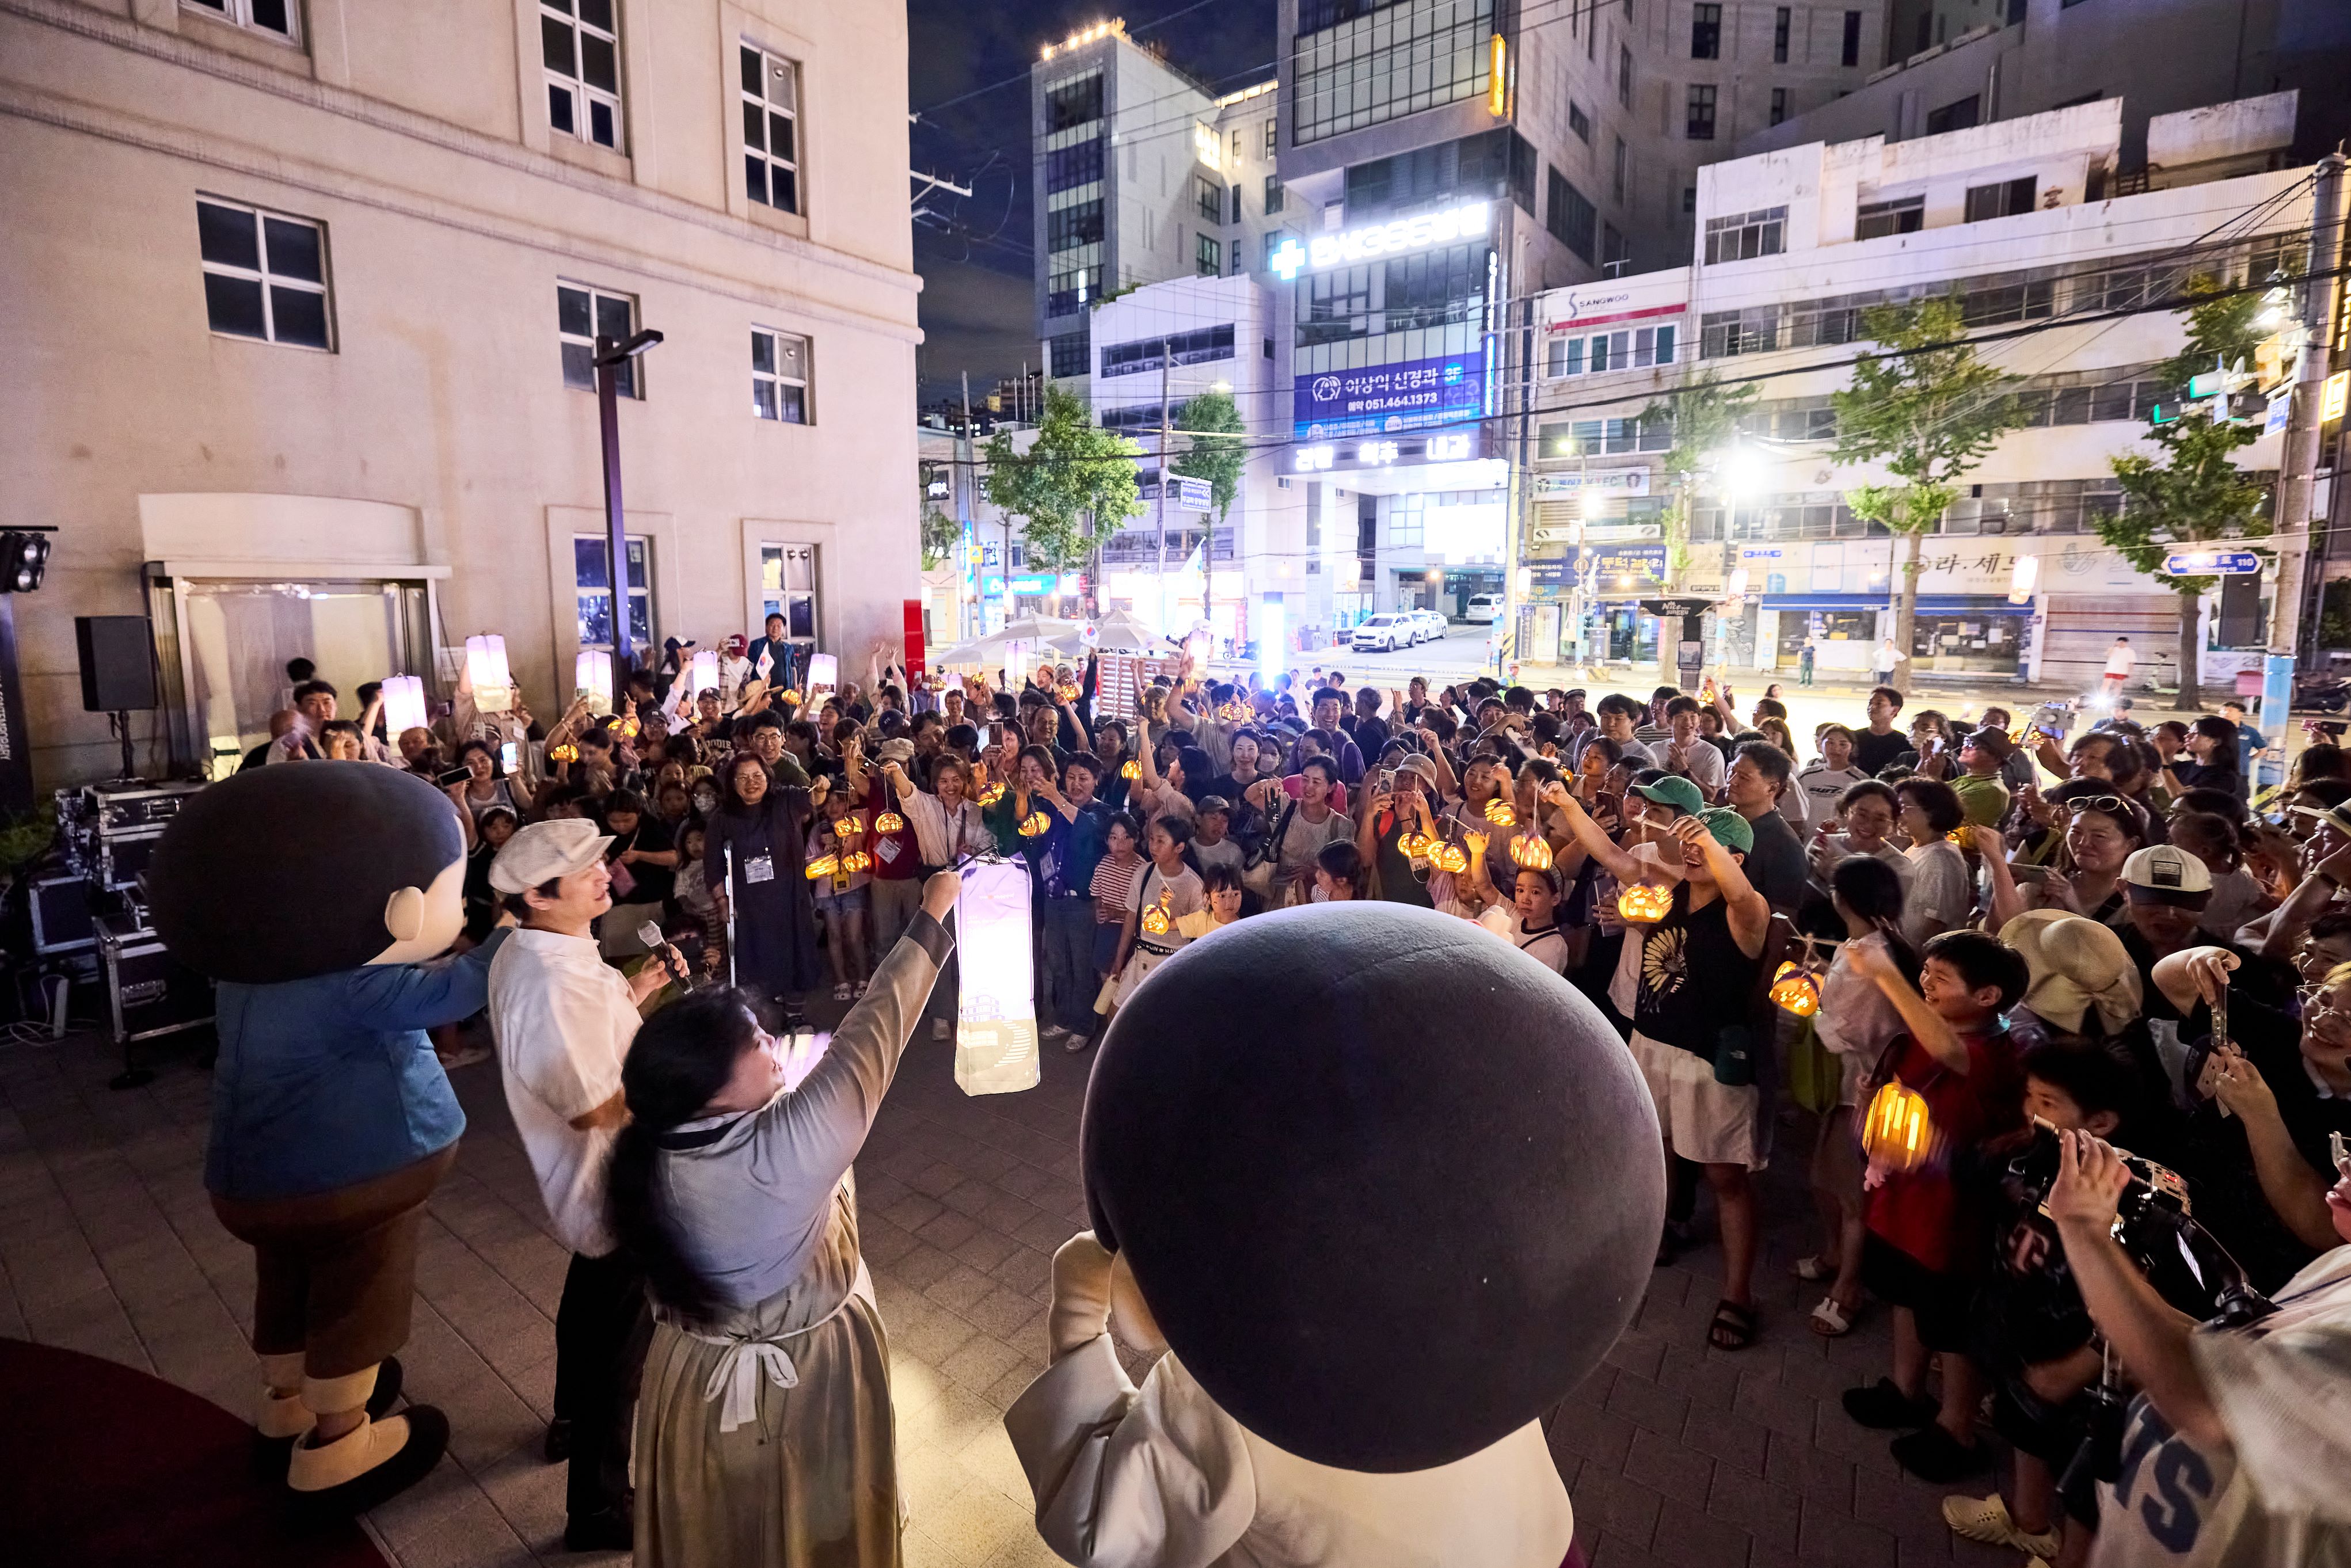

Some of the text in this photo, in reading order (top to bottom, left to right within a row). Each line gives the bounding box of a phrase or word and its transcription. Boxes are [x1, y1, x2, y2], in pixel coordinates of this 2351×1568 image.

[1580, 294, 1629, 307] SANGWOO
[1394, 367, 1439, 391] 신경과
[1444, 366, 1462, 382] 3F
[1348, 392, 1438, 412] 예약 051.464.1373
